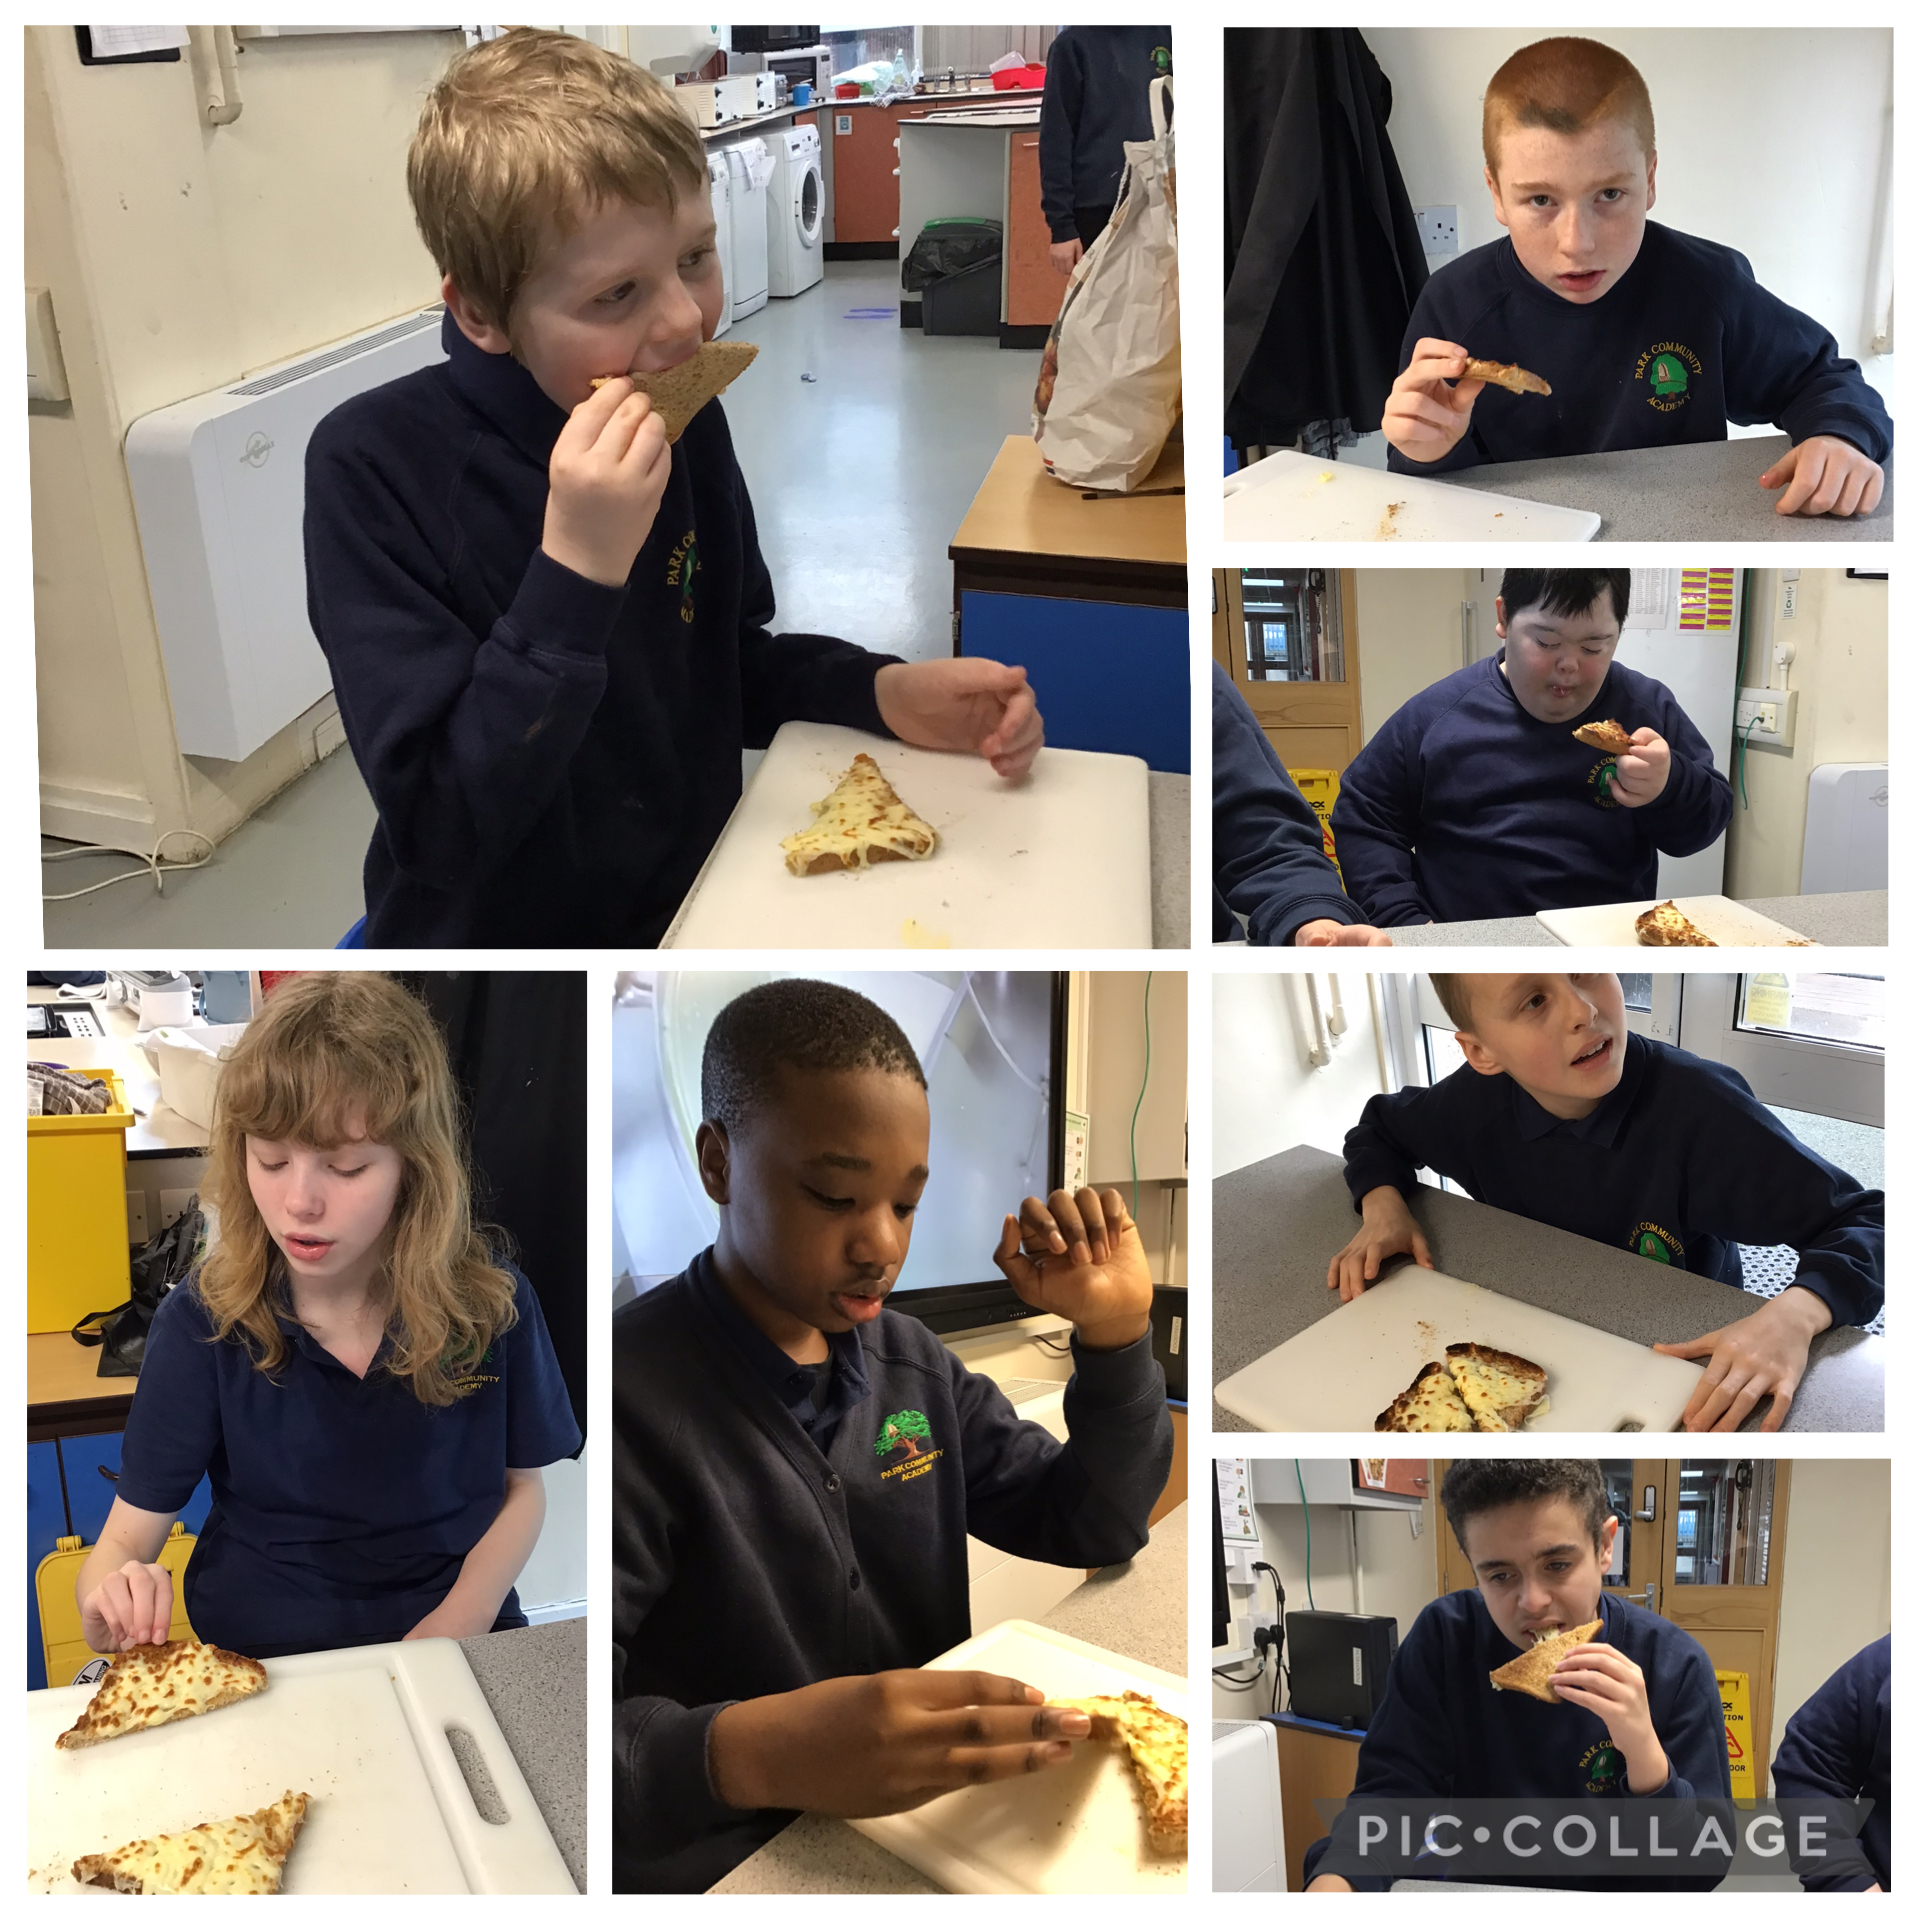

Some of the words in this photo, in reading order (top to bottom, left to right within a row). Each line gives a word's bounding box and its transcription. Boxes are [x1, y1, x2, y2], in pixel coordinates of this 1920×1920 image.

[1635, 352, 1652, 379] PARK
[1651, 342, 1703, 375] COMMUNITY
[1647, 392, 1691, 412] ACADEMY
[667, 545, 686, 586] PARK
[1587, 764, 1601, 784] PARK
[1640, 1221, 1685, 1256] COMMUNITY
[450, 1374, 500, 1385] COMMUNITY
[459, 1383, 483, 1391] DEMY
[880, 1464, 905, 1480] PARK
[904, 1448, 945, 1470] COMMUNITY
[901, 1462, 933, 1482] ACADEMY
[1579, 1745, 1599, 1768] PARK
[1729, 1764, 1746, 1772] OOR
